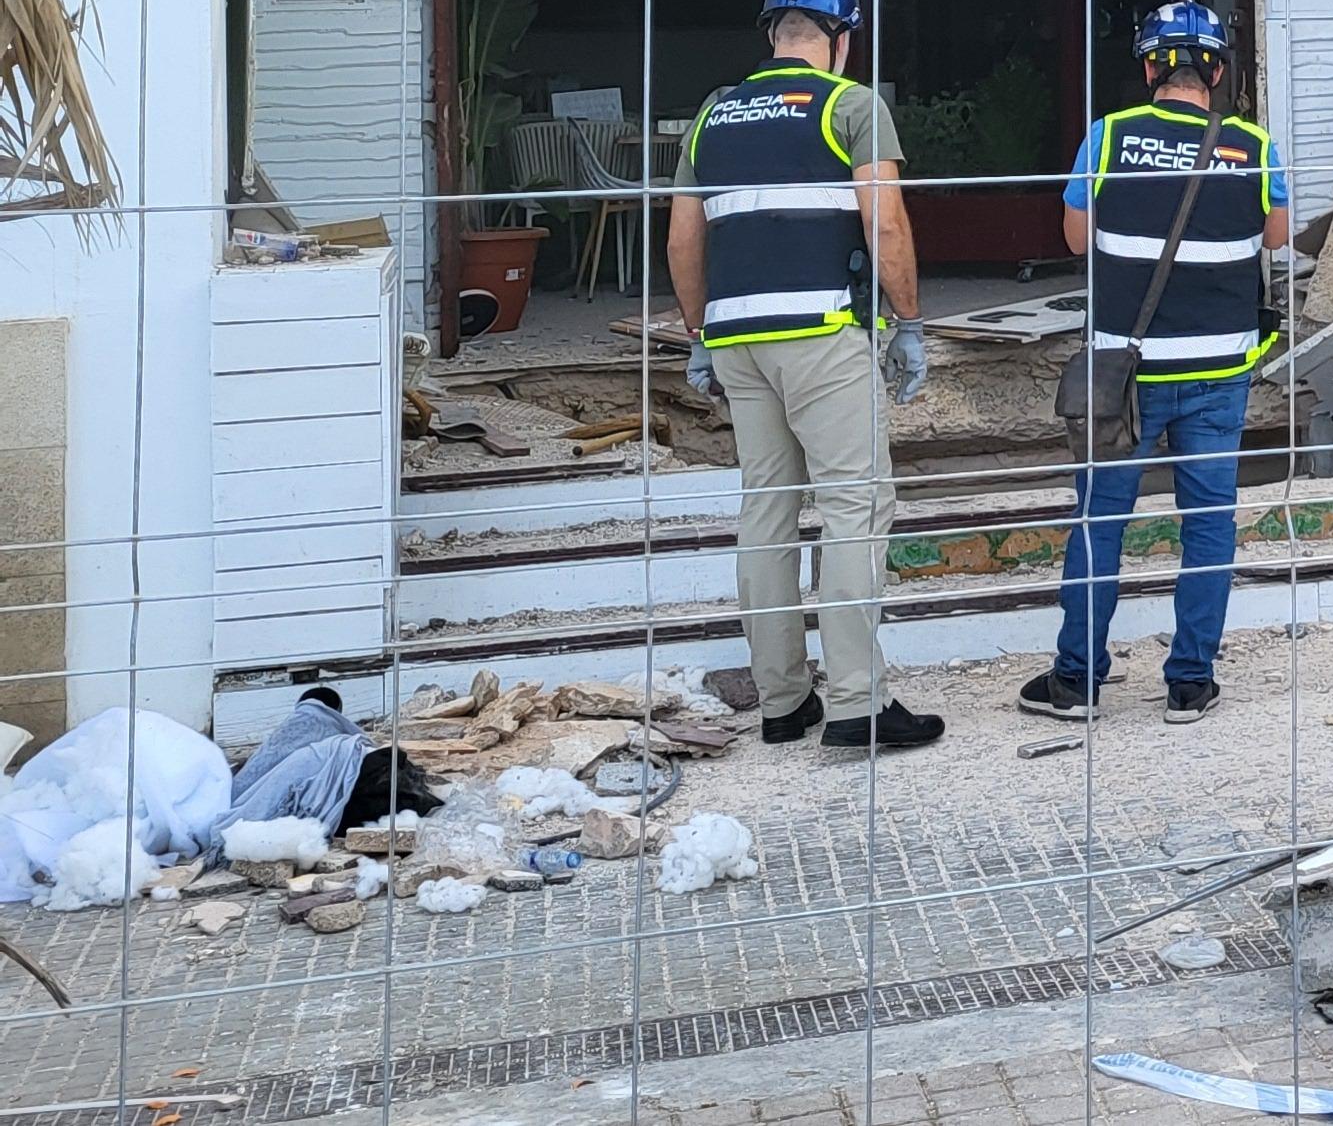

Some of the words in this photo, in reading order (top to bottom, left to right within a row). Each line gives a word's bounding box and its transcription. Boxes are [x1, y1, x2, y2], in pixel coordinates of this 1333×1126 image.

[710, 92, 785, 116] POLICIA
[704, 104, 808, 129] NACIONAL
[1121, 135, 1221, 159] POLIC
